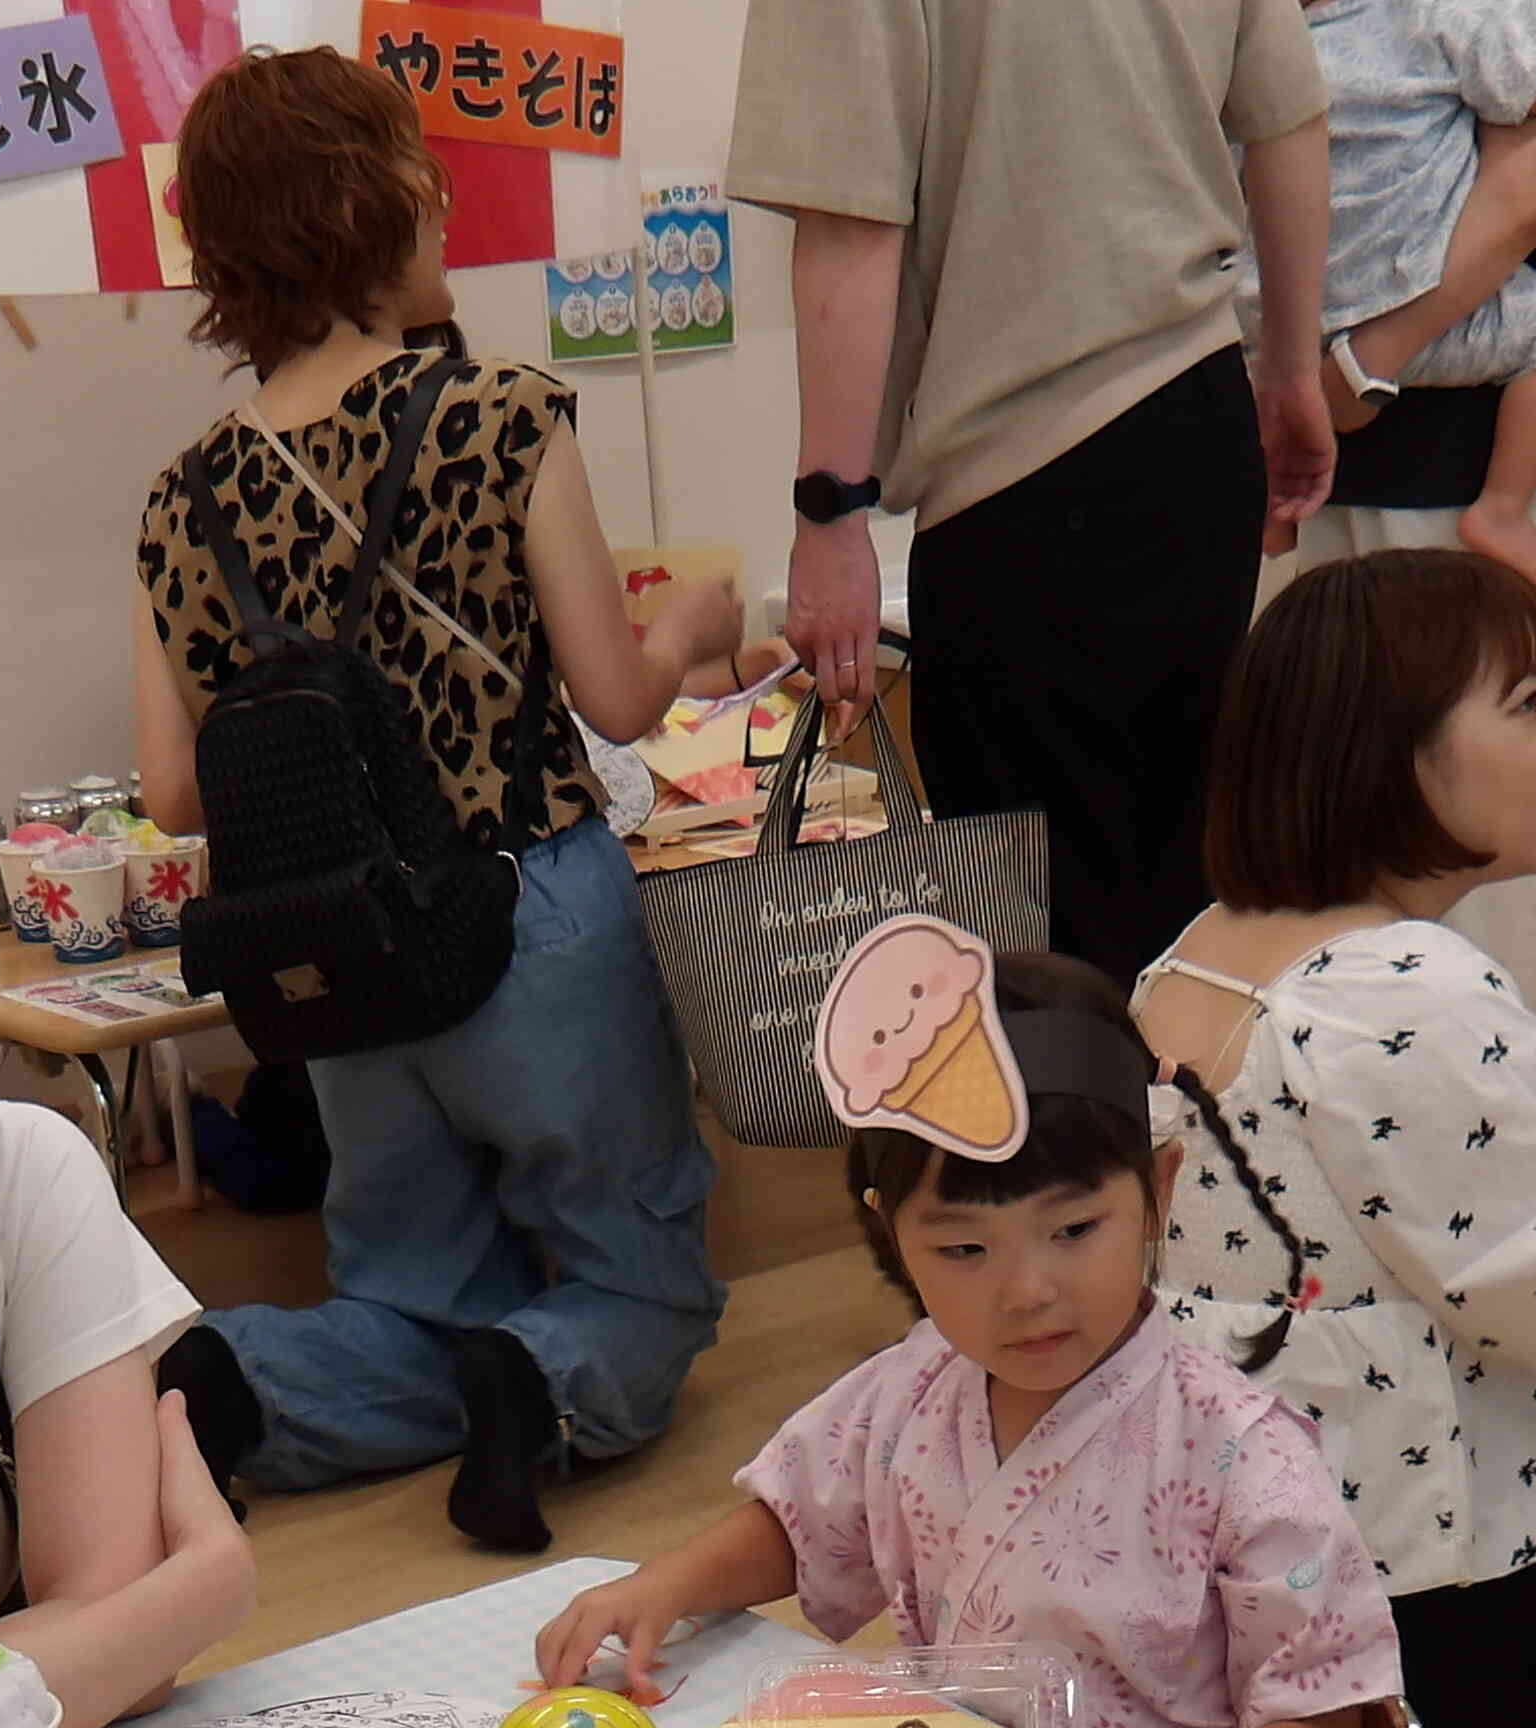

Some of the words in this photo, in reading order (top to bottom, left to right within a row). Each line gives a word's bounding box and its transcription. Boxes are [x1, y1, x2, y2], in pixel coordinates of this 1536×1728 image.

[376, 32, 617, 136] やきそば
[147, 860, 193, 903] 氷
[803, 888, 872, 922] order
[878, 884, 907, 909] to
[916, 873, 941, 905] be
